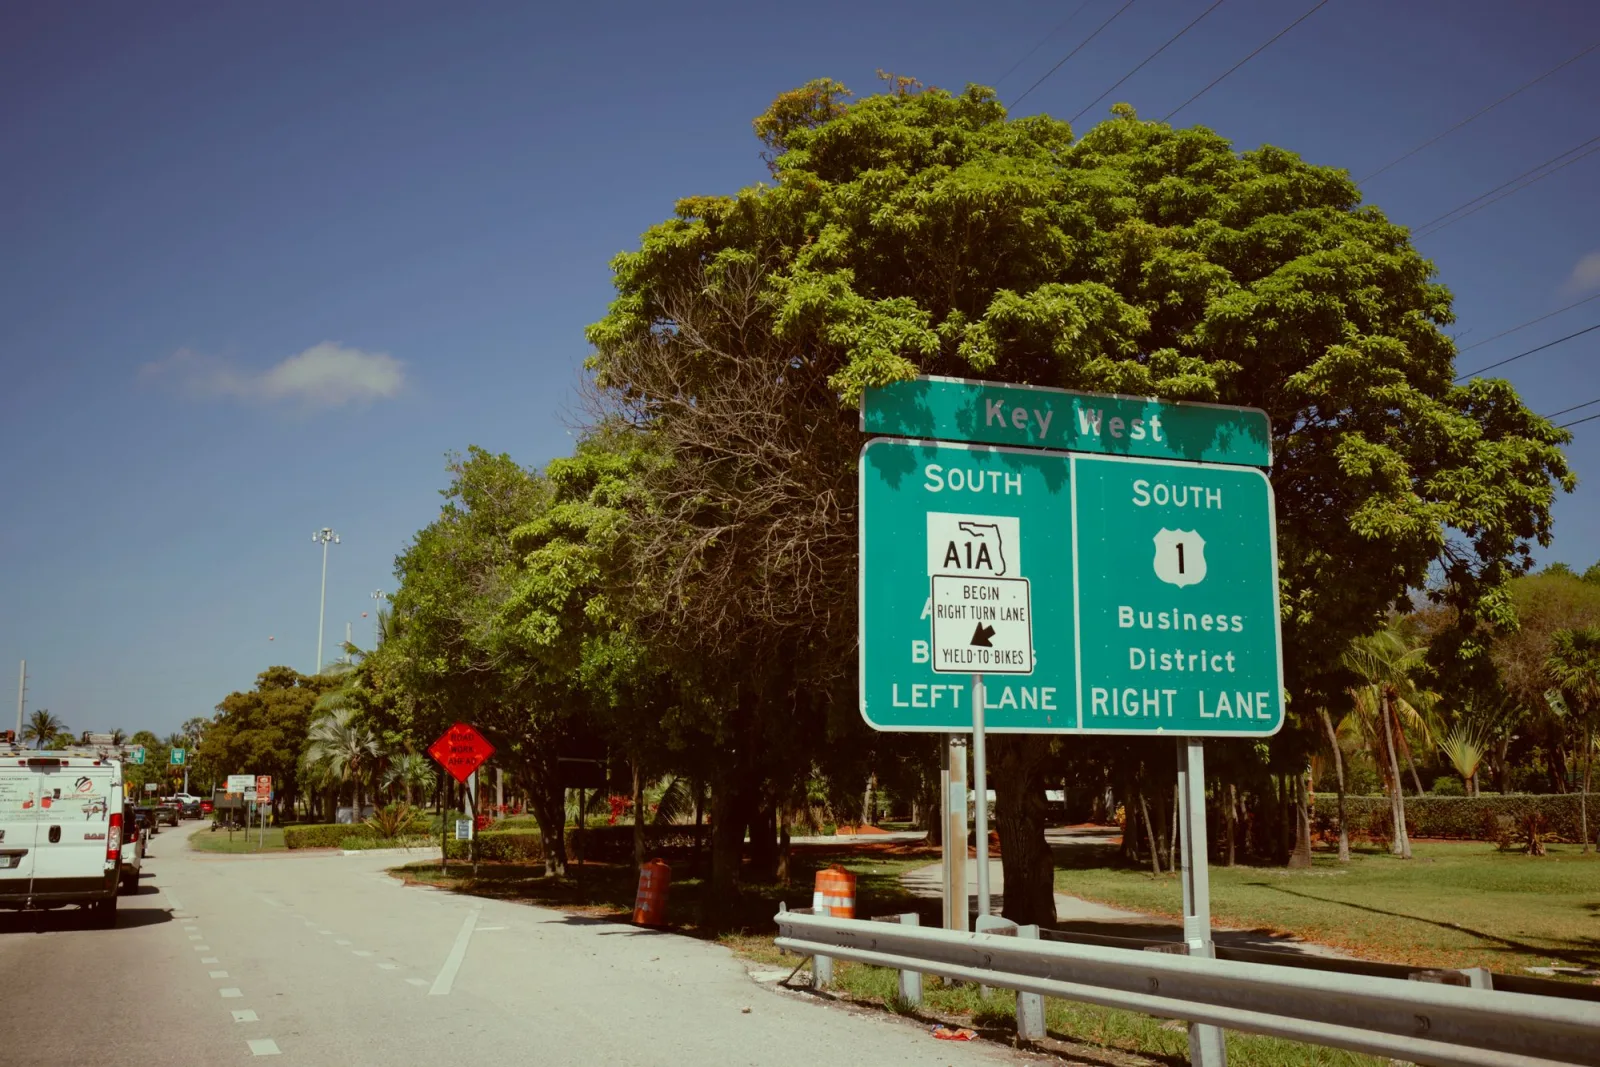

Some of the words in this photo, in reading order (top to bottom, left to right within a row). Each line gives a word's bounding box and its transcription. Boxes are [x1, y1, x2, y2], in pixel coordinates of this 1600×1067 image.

[985, 398, 1054, 439] Key
[1077, 406, 1162, 442] West
[923, 463, 1022, 495] SOUTH
[1132, 479, 1222, 510] SOUTH
[943, 540, 993, 570] A1A
[1175, 542, 1185, 574] 1
[963, 585, 1000, 600] BEGIN
[937, 604, 967, 619] RIGHT
[970, 605, 996, 620] TURN
[1000, 606, 1025, 621] LANE
[1118, 605, 1244, 632] Business
[942, 648, 973, 663] YIELD
[977, 649, 989, 664] TO
[995, 650, 1024, 664] BIKES
[1129, 647, 1236, 673] District
[892, 683, 964, 708] LEFT
[982, 685, 1057, 710] LANE
[1091, 687, 1177, 717] RIGHT
[1199, 690, 1272, 719] LANE
[450, 733, 475, 741] ROAD
[450, 745, 474, 753] WORK
